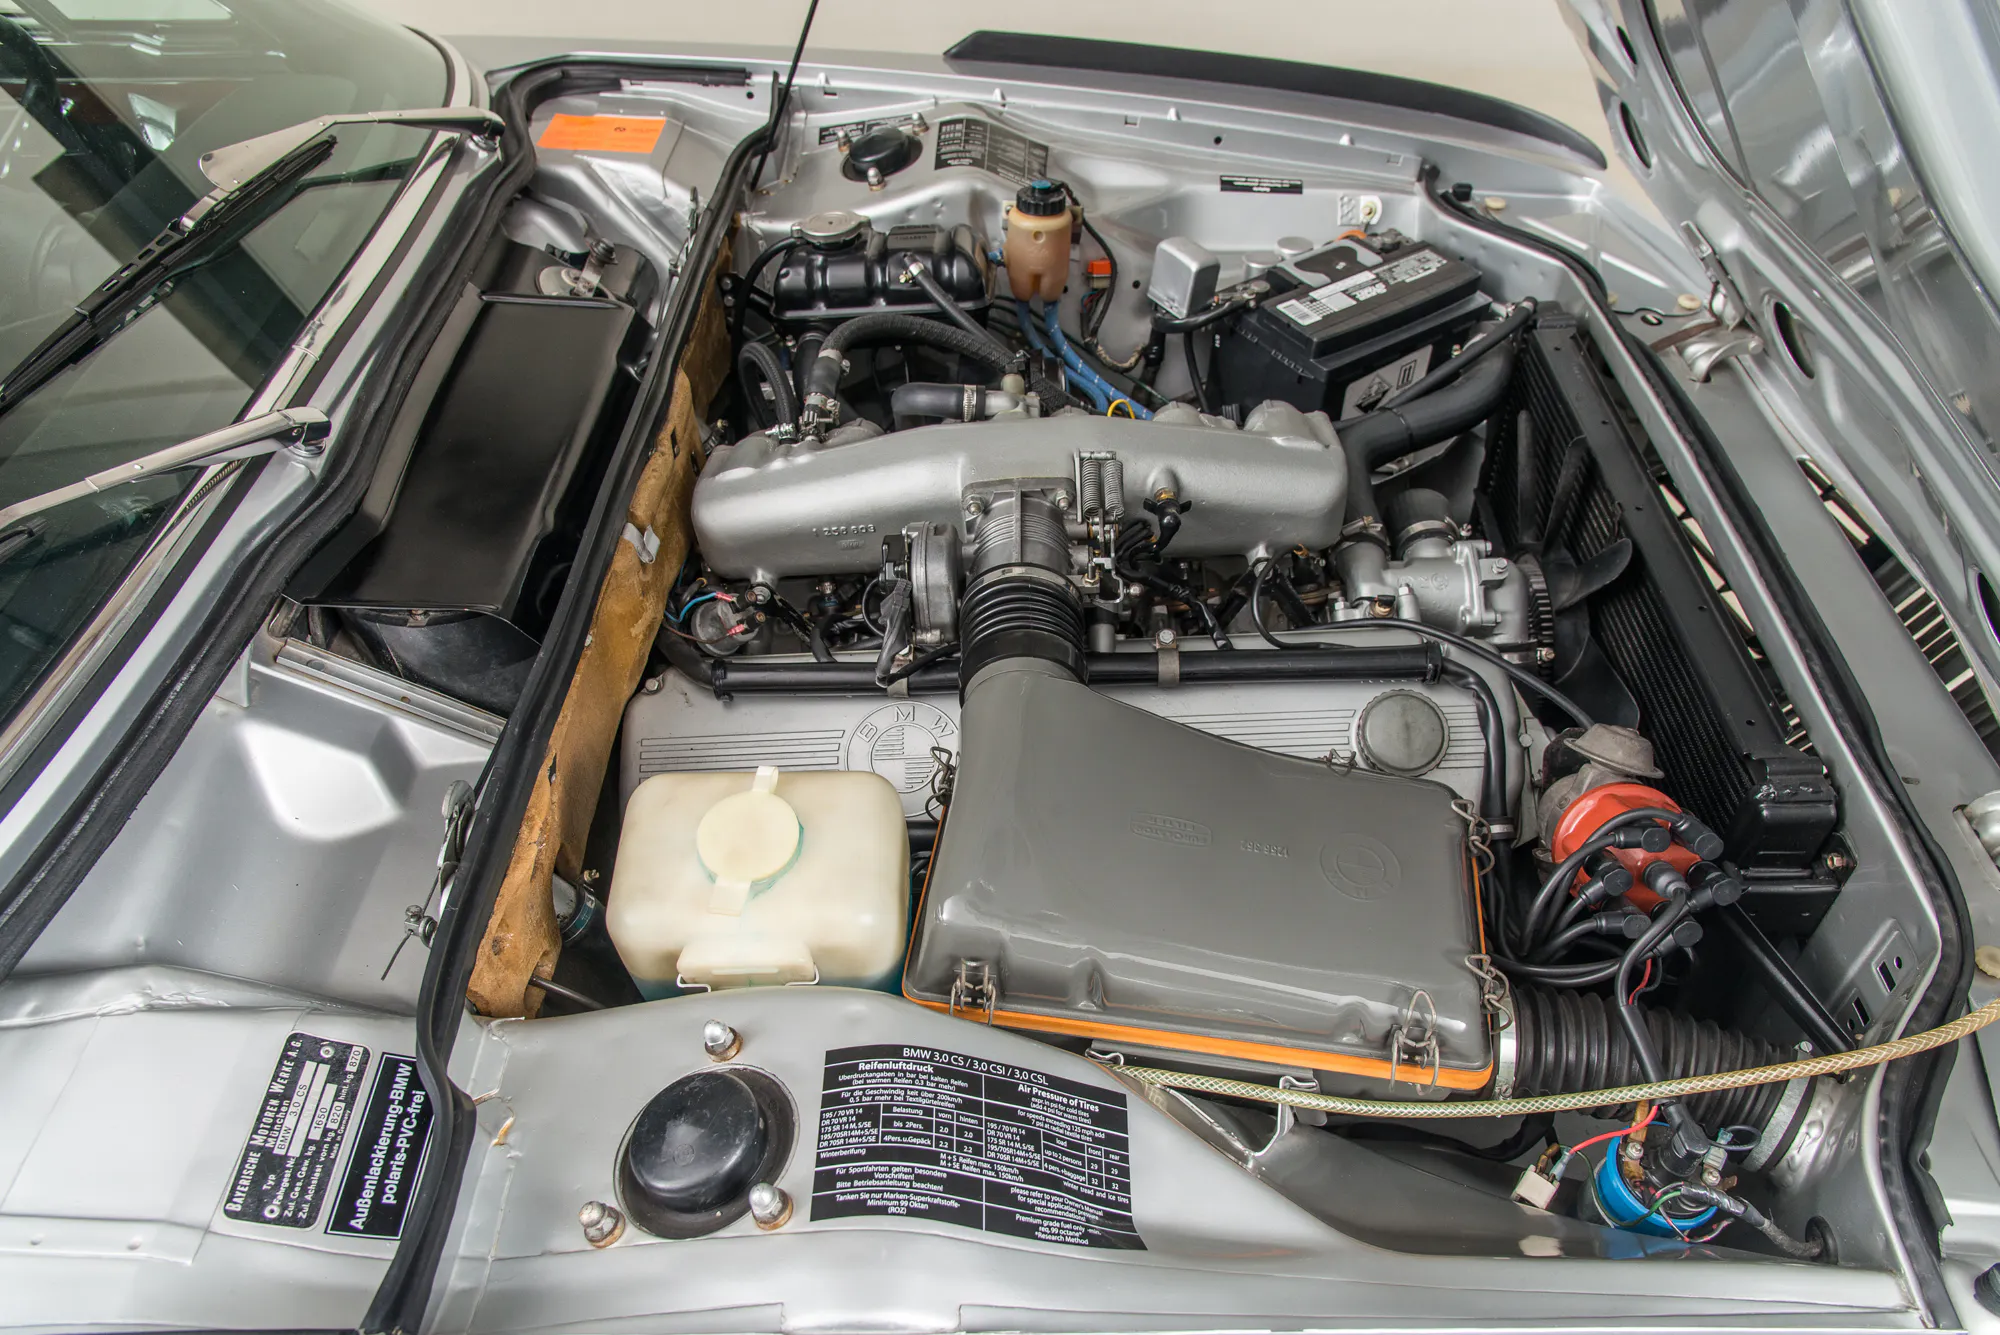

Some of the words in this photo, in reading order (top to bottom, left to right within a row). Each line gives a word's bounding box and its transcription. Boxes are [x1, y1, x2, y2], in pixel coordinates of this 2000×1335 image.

[856, 706, 954, 742] BMW
[858, 1061, 934, 1073] Reifenluftdruck
[903, 1048, 931, 1059] BMW
[933, 1052, 948, 1062] 3,0
[951, 1055, 964, 1066] CS
[966, 1059, 971, 1068] /
[973, 1060, 988, 1071] 3,0
[989, 1064, 1005, 1075] CSI
[1007, 1068, 1012, 1076] /
[1014, 1069, 1028, 1080] 3,0
[1031, 1073, 1048, 1085] CSL
[931, 1075, 948, 1084] kalten
[950, 1079, 968, 1088] Reifen
[938, 1083, 956, 1091] mehr)
[937, 1094, 962, 1104] 200km/h
[1018, 1084, 1031, 1093] Air
[1032, 1087, 1068, 1104] Pressure
[1079, 1100, 1099, 1112] Tires
[264, 1100, 290, 1148] München
[314, 1107, 328, 1129] 1650
[892, 1106, 923, 1116] Belastung
[960, 1115, 978, 1125] hinten
[1026, 1112, 1045, 1121] speeds
[1046, 1118, 1070, 1130] exceeding
[1064, 1112, 1078, 1120] warm
[304, 1164, 323, 1200] Achslast
[319, 1144, 330, 1161] vorn
[330, 1105, 342, 1124] 820
[349, 1050, 360, 1067] 870
[1050, 1125, 1064, 1134] radial
[225, 1152, 261, 1212] BAYERISCHE
[249, 1099, 280, 1146] MOTOREN
[268, 1060, 294, 1093] WERKE
[262, 1174, 276, 1190] Typ
[278, 1125, 292, 1149] BMW
[289, 1102, 301, 1116] 3.0
[296, 1084, 308, 1097] CS
[350, 1062, 412, 1230] Außenlackierung-BMW
[381, 1090, 426, 1204] polaris-PVC-frei
[1056, 1138, 1067, 1147] load
[1088, 1148, 1102, 1156] front
[959, 1156, 977, 1166] Reifen
[994, 1164, 1019, 1175] 150km/h
[1063, 1155, 1082, 1166] persons
[848, 1166, 889, 1174] Sportfahrten
[914, 1167, 947, 1178] besondere
[962, 1164, 980, 1173] Reifen
[999, 1172, 1024, 1182] 150km/h
[854, 1179, 910, 1188] Betriebsanleitung
[1011, 1187, 1029, 1196] please
[1030, 1190, 1043, 1198] refer
[1080, 1187, 1094, 1196] tread
[1117, 1196, 1129, 1204] tires
[888, 1206, 907, 1215] (ROZ)
[909, 1201, 928, 1210] Oktan
[1027, 1198, 1046, 1206] special
[1047, 1202, 1077, 1214] application
[1016, 1214, 1042, 1224] Premium
[1043, 1219, 1060, 1228] grade
[1061, 1221, 1072, 1229] fuel
[1073, 1224, 1085, 1233] only
[1065, 1235, 1089, 1245] Method
